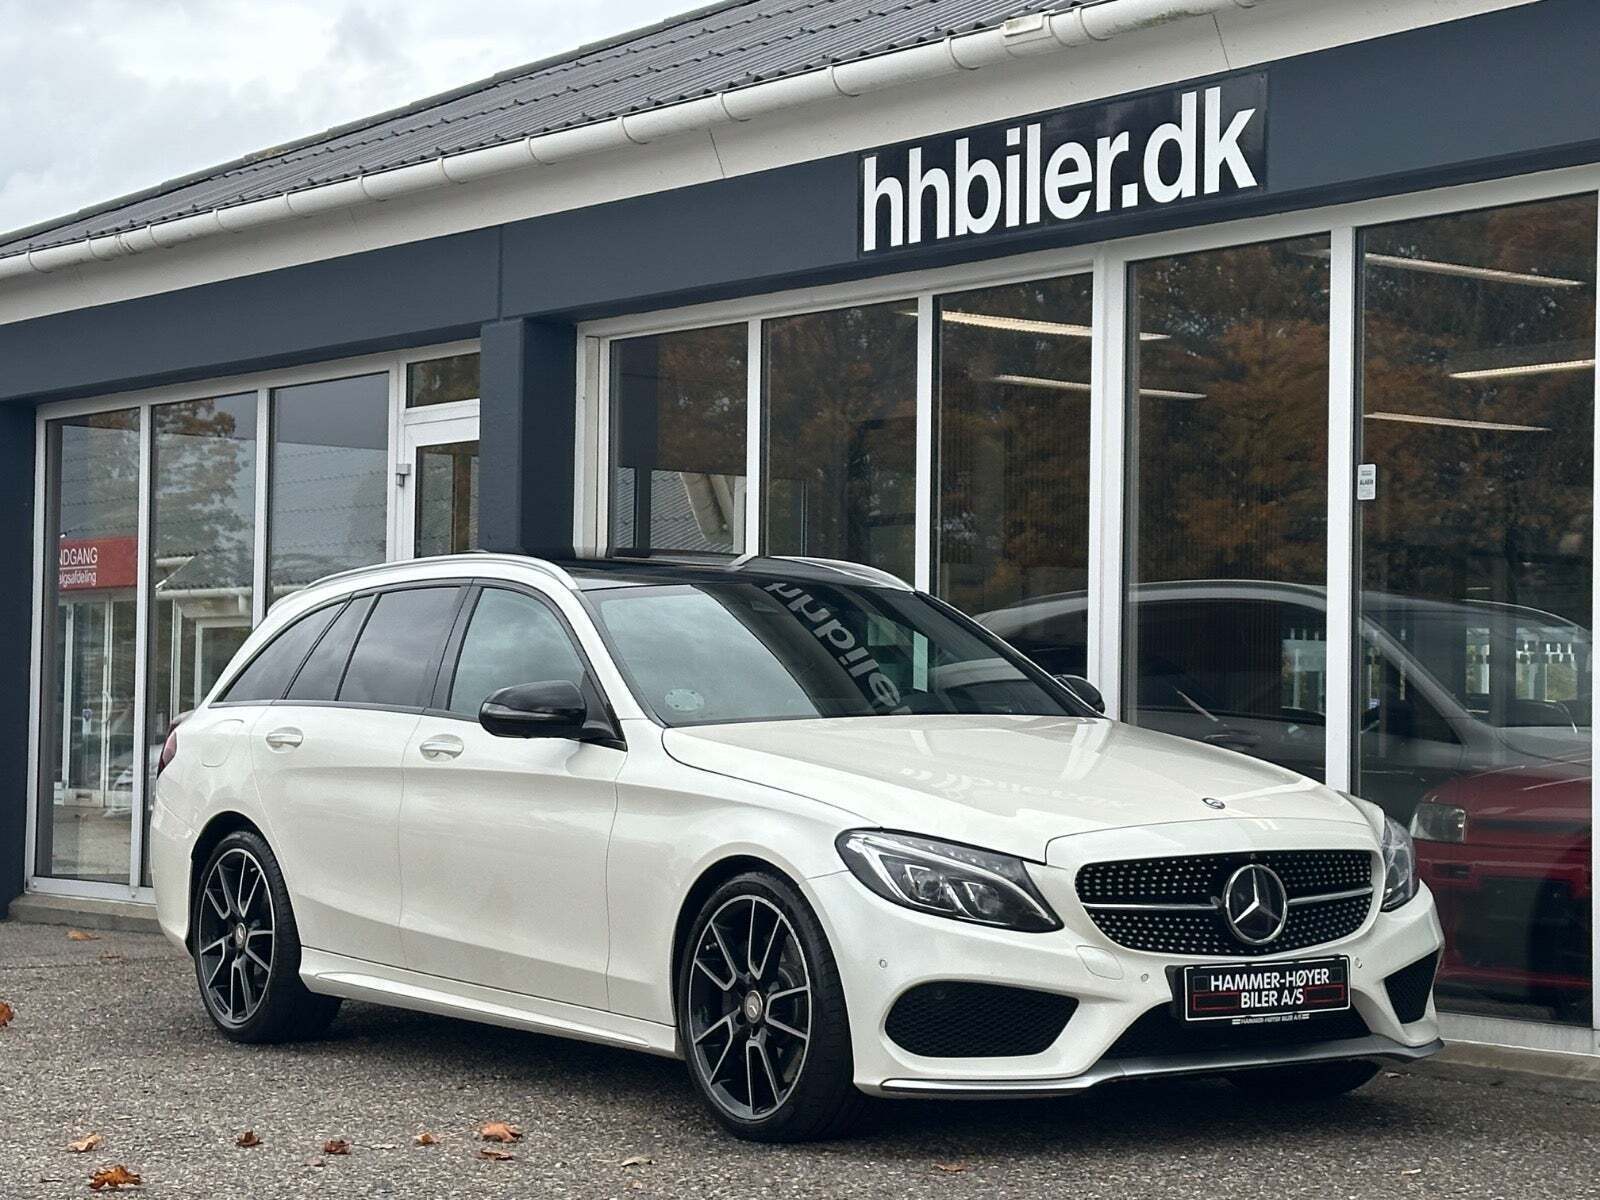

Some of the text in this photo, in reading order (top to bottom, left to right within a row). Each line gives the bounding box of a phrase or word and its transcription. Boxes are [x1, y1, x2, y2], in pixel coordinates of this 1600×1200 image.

[863, 86, 1258, 252] hhbiler.dk
[1210, 968, 1330, 991] HAMMER-HØYER
[1240, 988, 1304, 1009] BILER A/S
